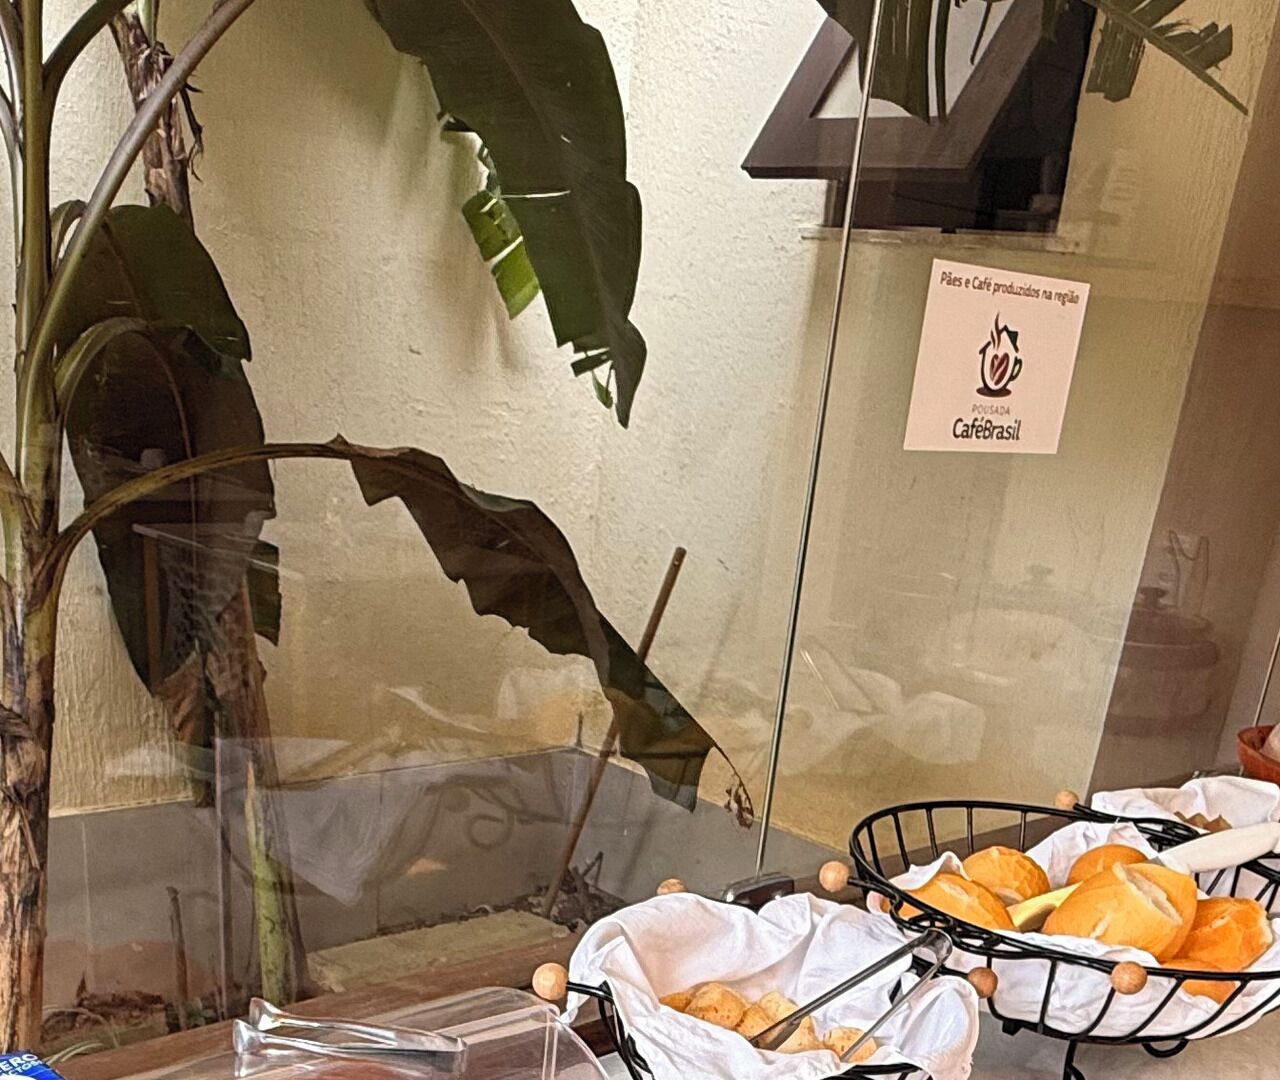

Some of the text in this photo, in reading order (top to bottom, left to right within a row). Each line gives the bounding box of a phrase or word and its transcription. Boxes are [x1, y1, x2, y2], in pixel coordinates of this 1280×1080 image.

[940, 271, 1080, 306] Pães e Café produzidos na região
[972, 404, 1011, 416] POUSADA
[952, 417, 1022, 441] CaféBrasil
